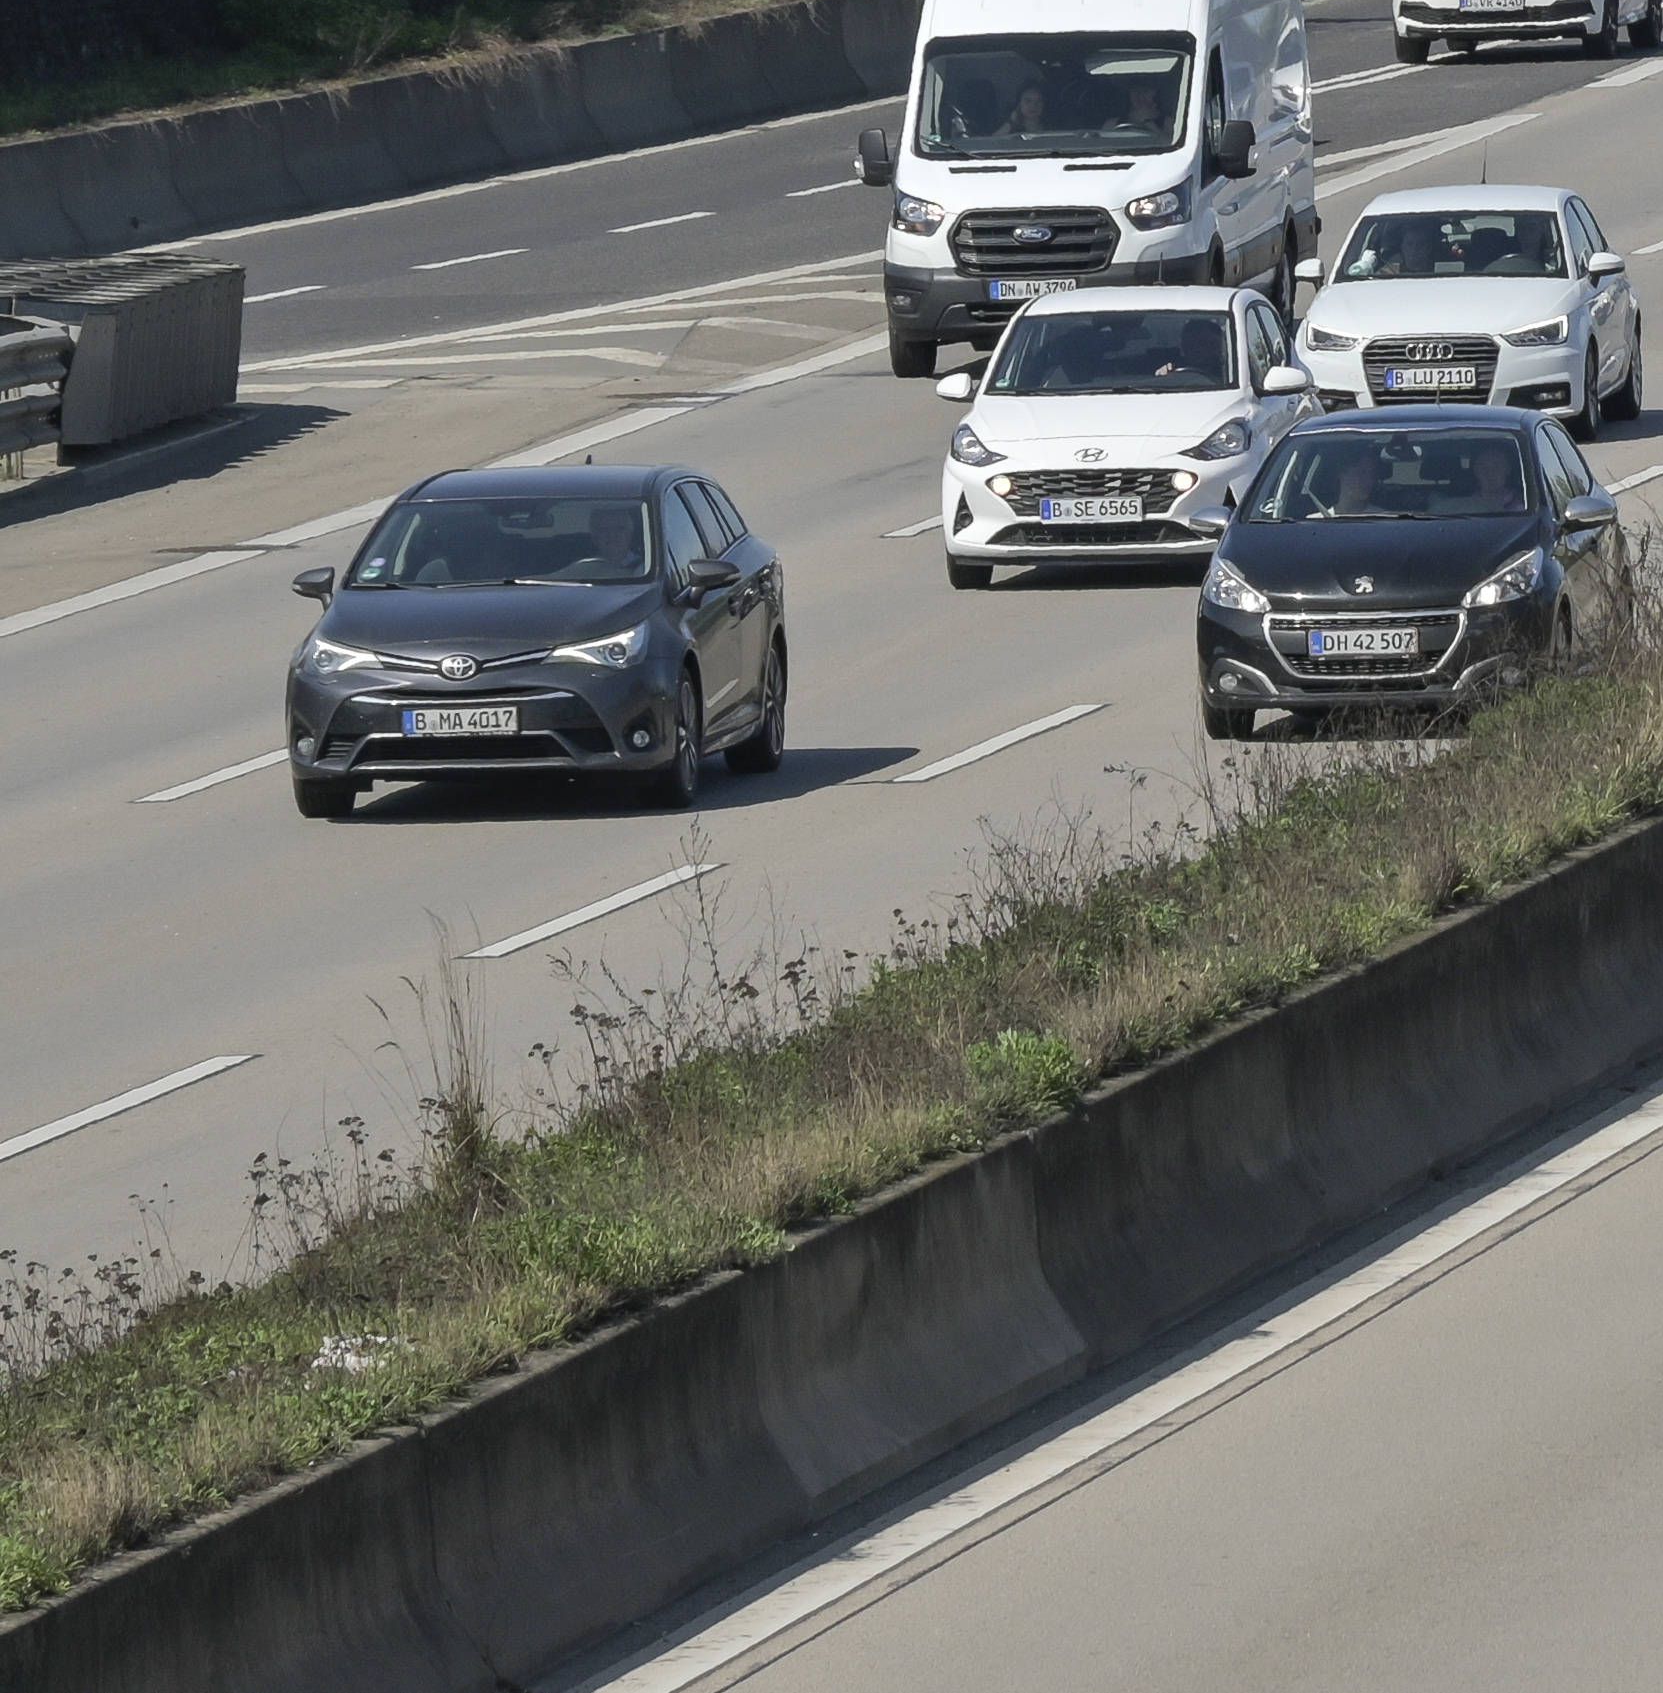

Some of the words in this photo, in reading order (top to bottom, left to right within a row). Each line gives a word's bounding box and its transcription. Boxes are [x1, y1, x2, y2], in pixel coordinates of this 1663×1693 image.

[1395, 371, 1405, 386] B
[1414, 370, 1433, 385] LU
[1437, 369, 1474, 385] 2110
[1052, 501, 1063, 518] B
[1074, 500, 1096, 517] SE
[1099, 499, 1139, 516] 6565
[1323, 634, 1350, 651] DH
[1353, 632, 1376, 651] 42
[1380, 631, 1415, 650] 507
[415, 714, 428, 731] B
[439, 712, 464, 730] MA
[467, 710, 515, 729] 4017
